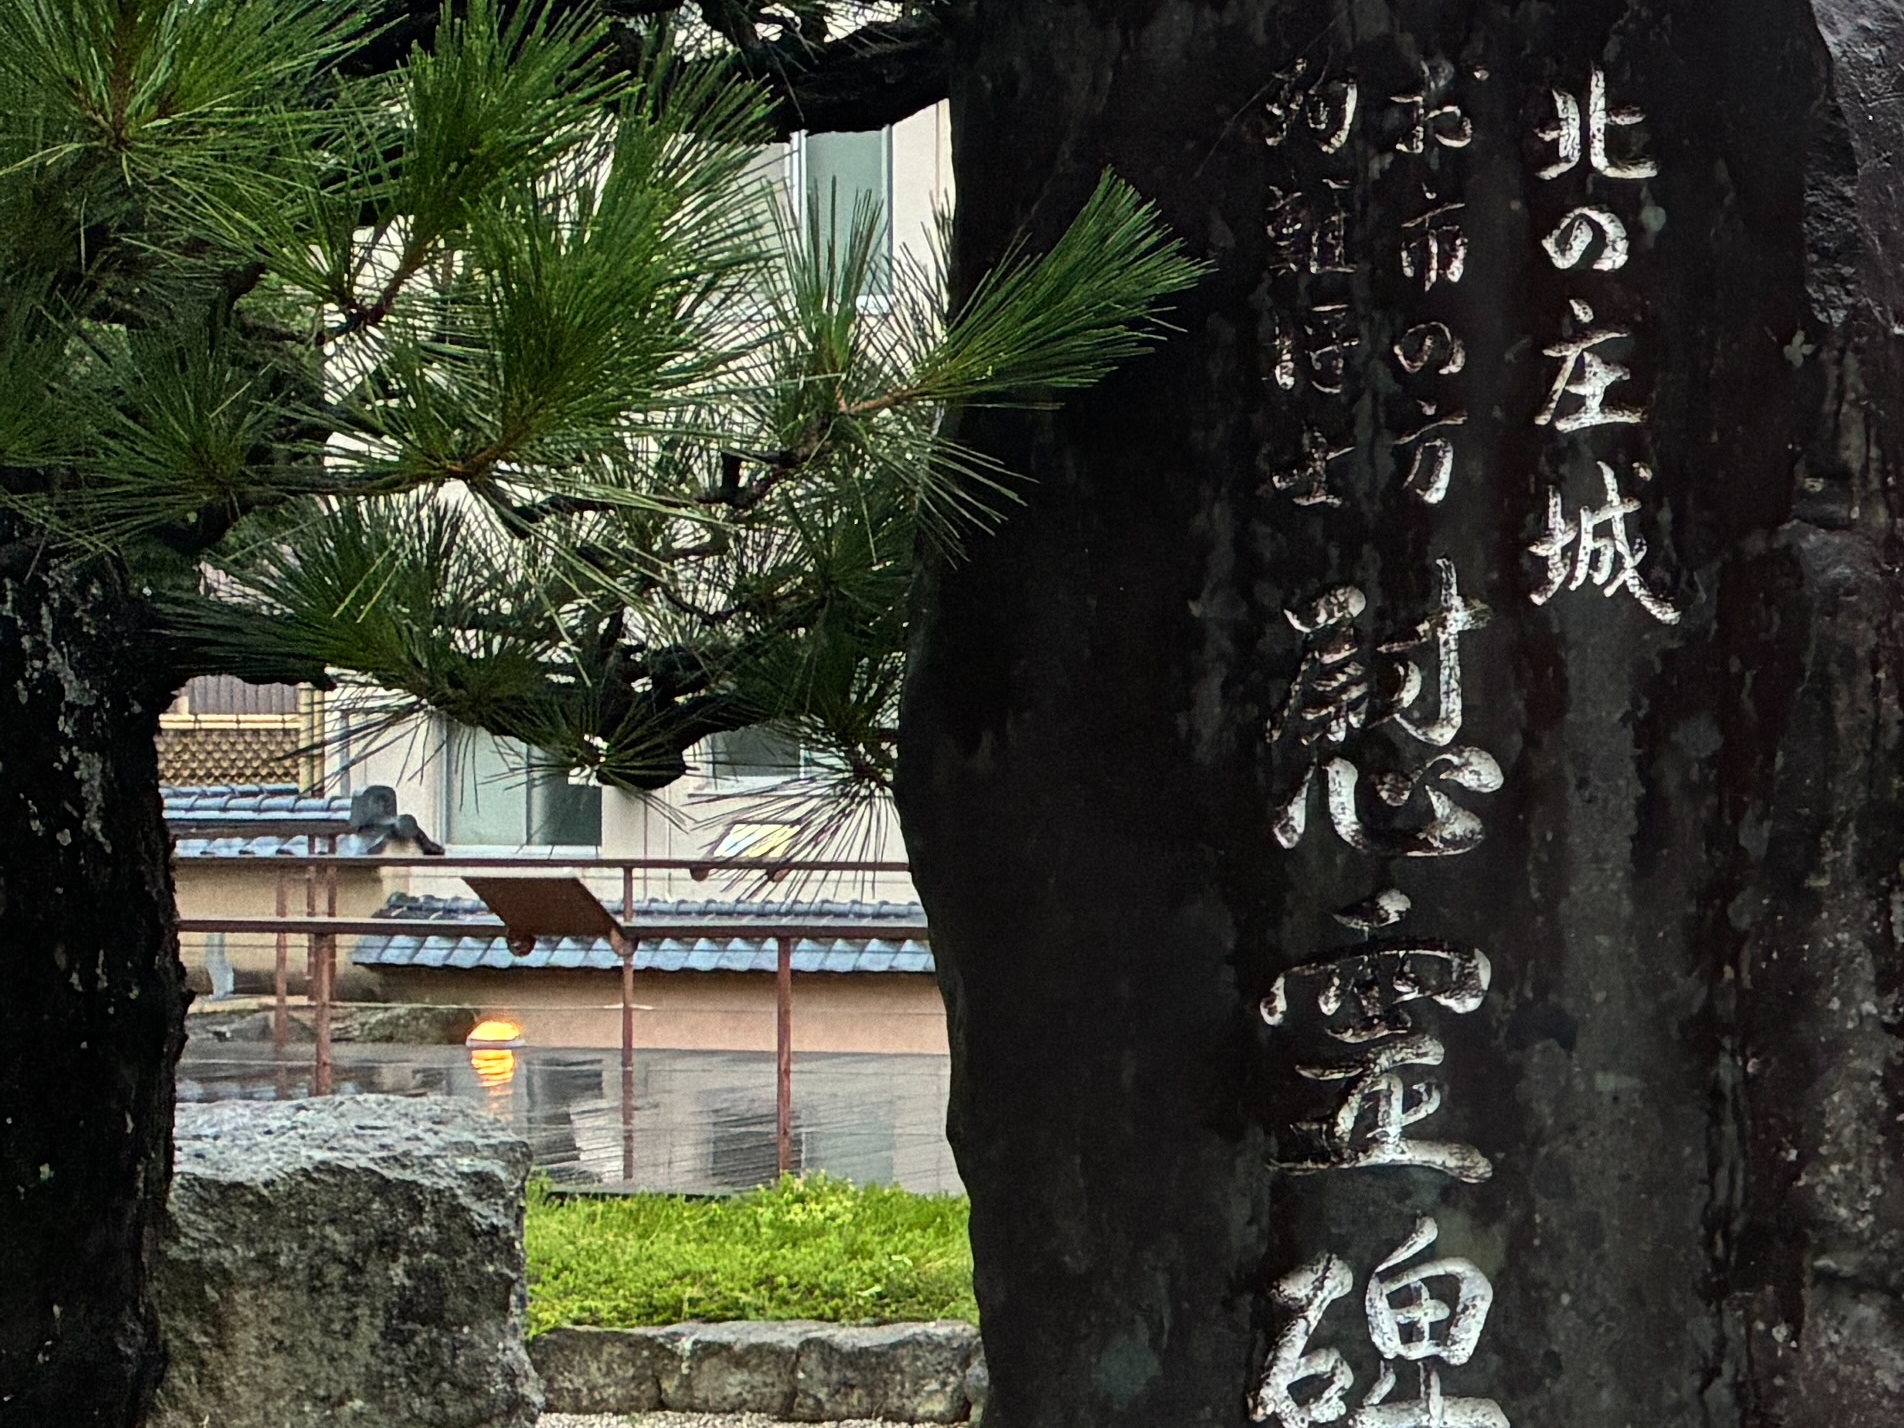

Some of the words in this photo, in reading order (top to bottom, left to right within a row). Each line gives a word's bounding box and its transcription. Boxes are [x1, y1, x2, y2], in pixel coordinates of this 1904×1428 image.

[1390, 56, 1489, 506] お市の方
[1532, 68, 1682, 626] 北の庄城
